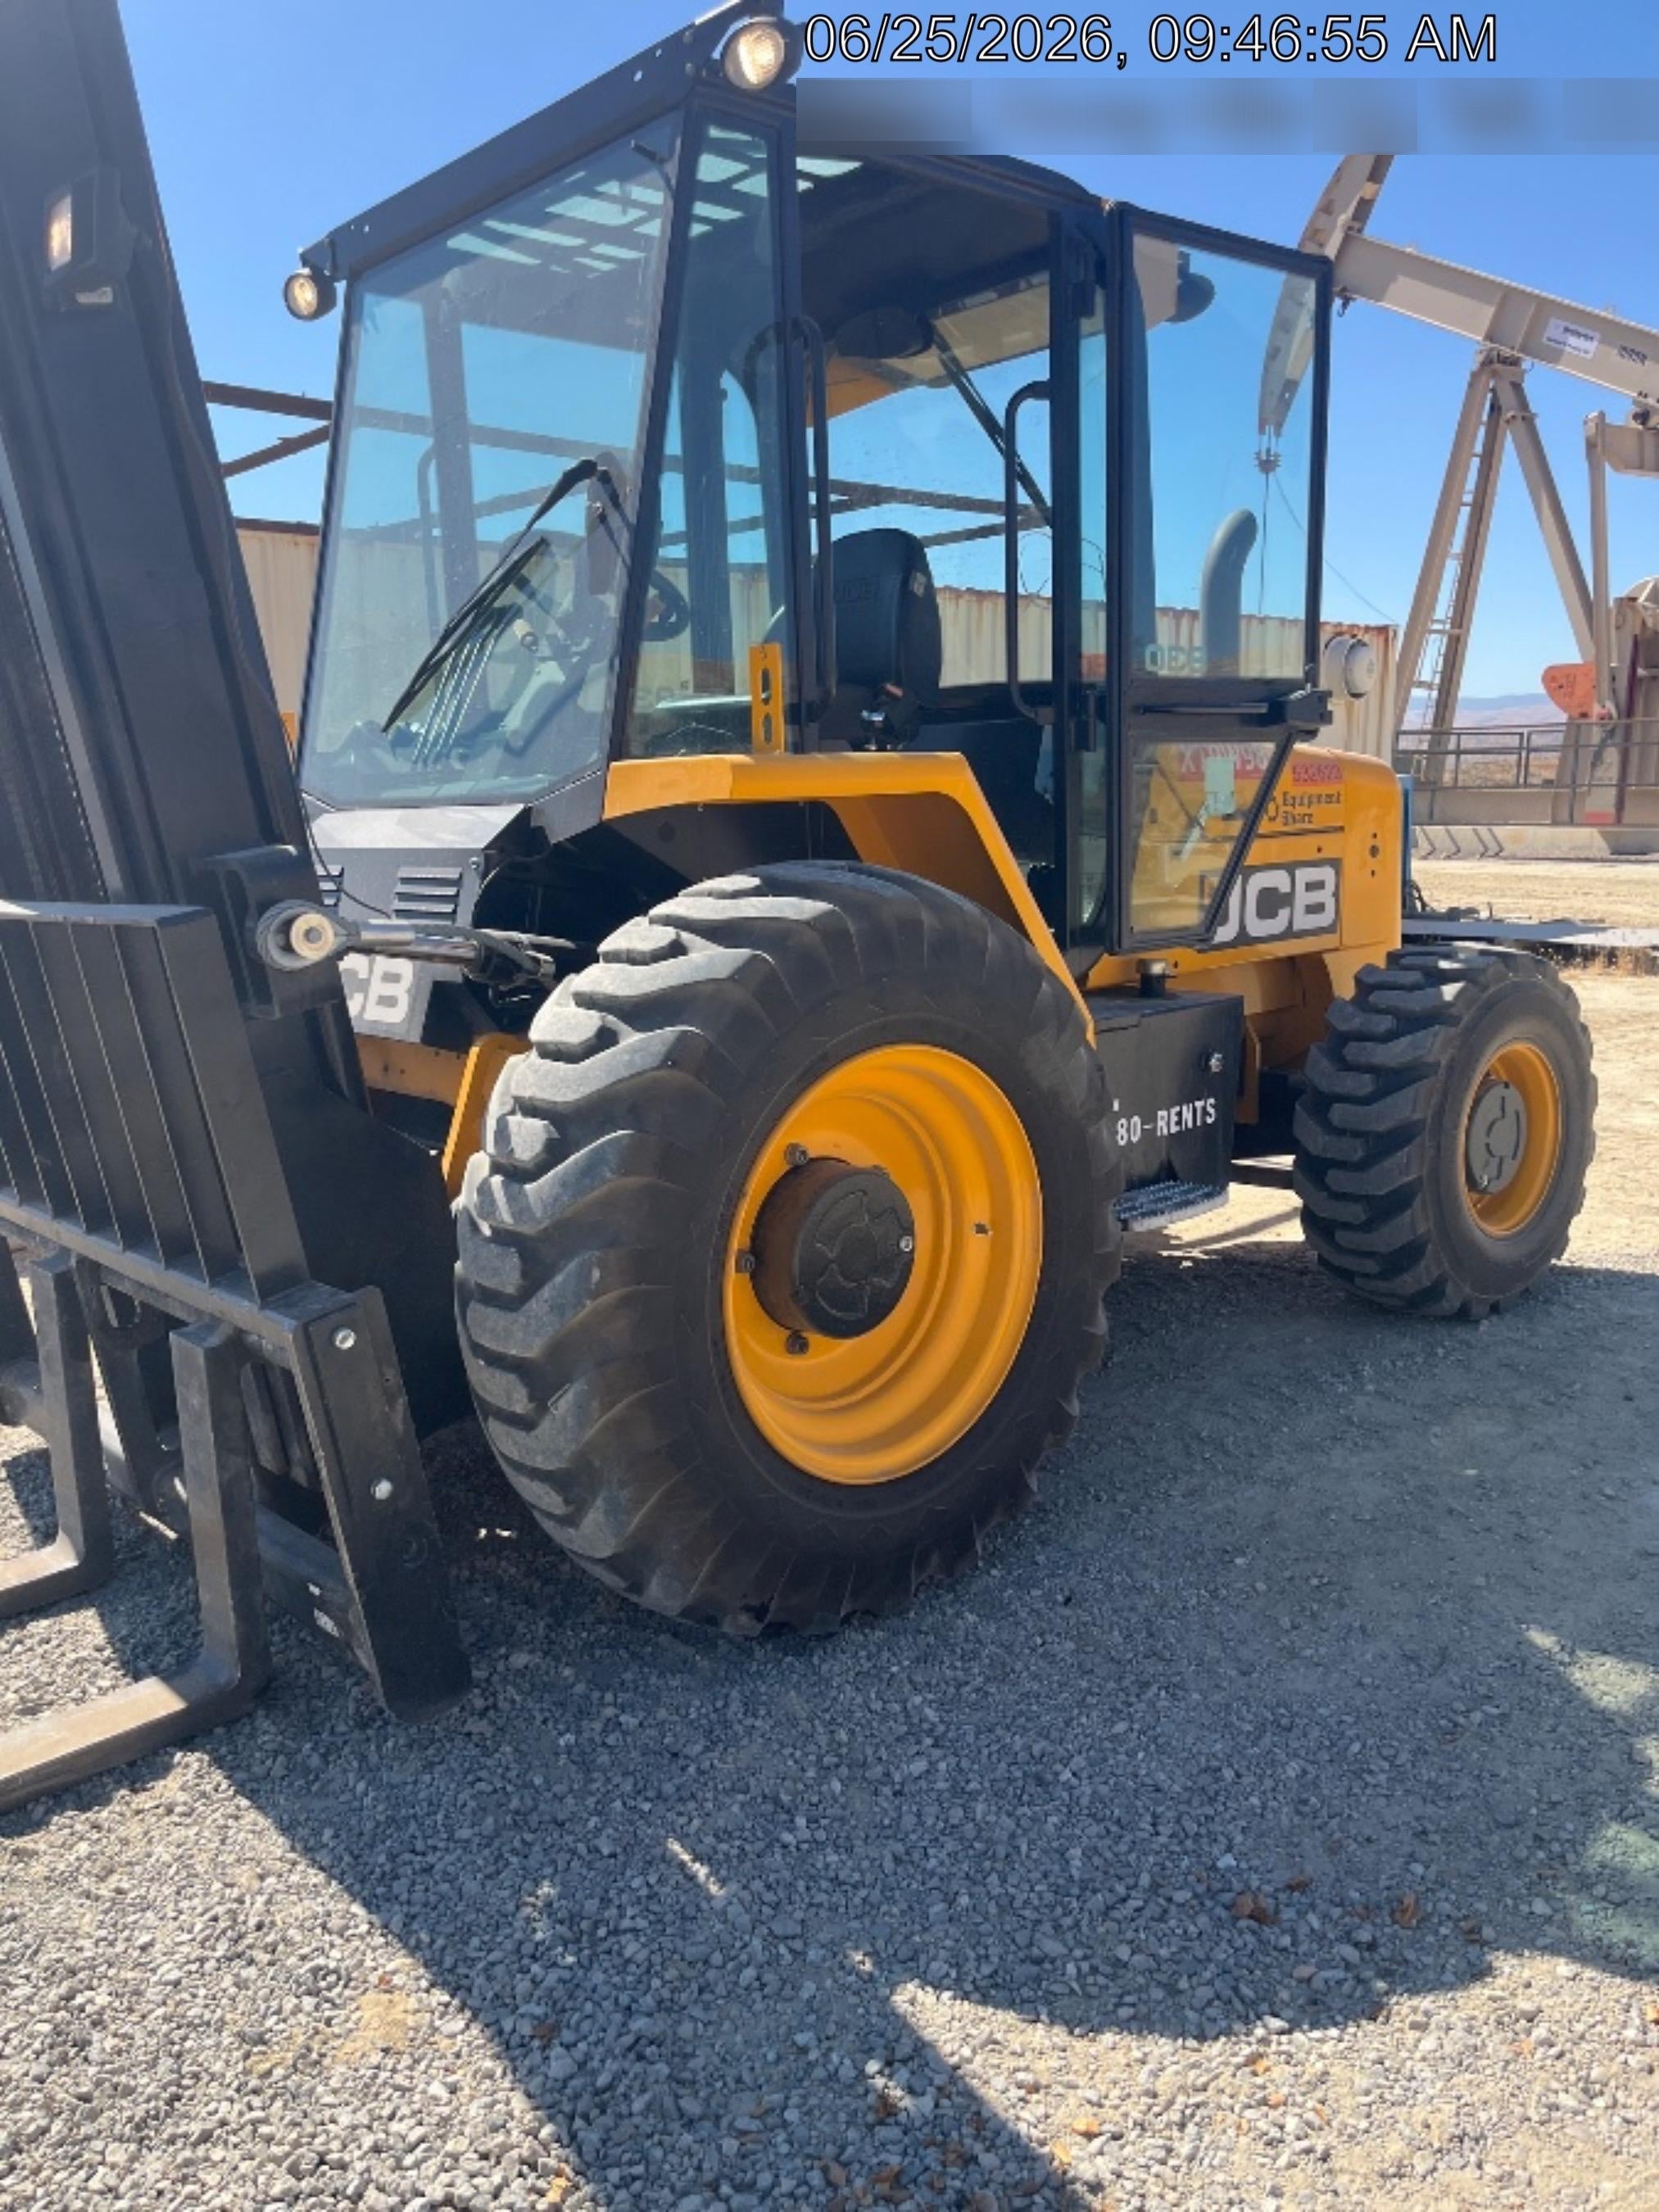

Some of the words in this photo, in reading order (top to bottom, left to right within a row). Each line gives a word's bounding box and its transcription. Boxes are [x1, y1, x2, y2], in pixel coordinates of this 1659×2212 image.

[1282, 790, 1341, 809] Equipment
[1282, 809, 1313, 827] Share
[338, 953, 414, 1023] CB
